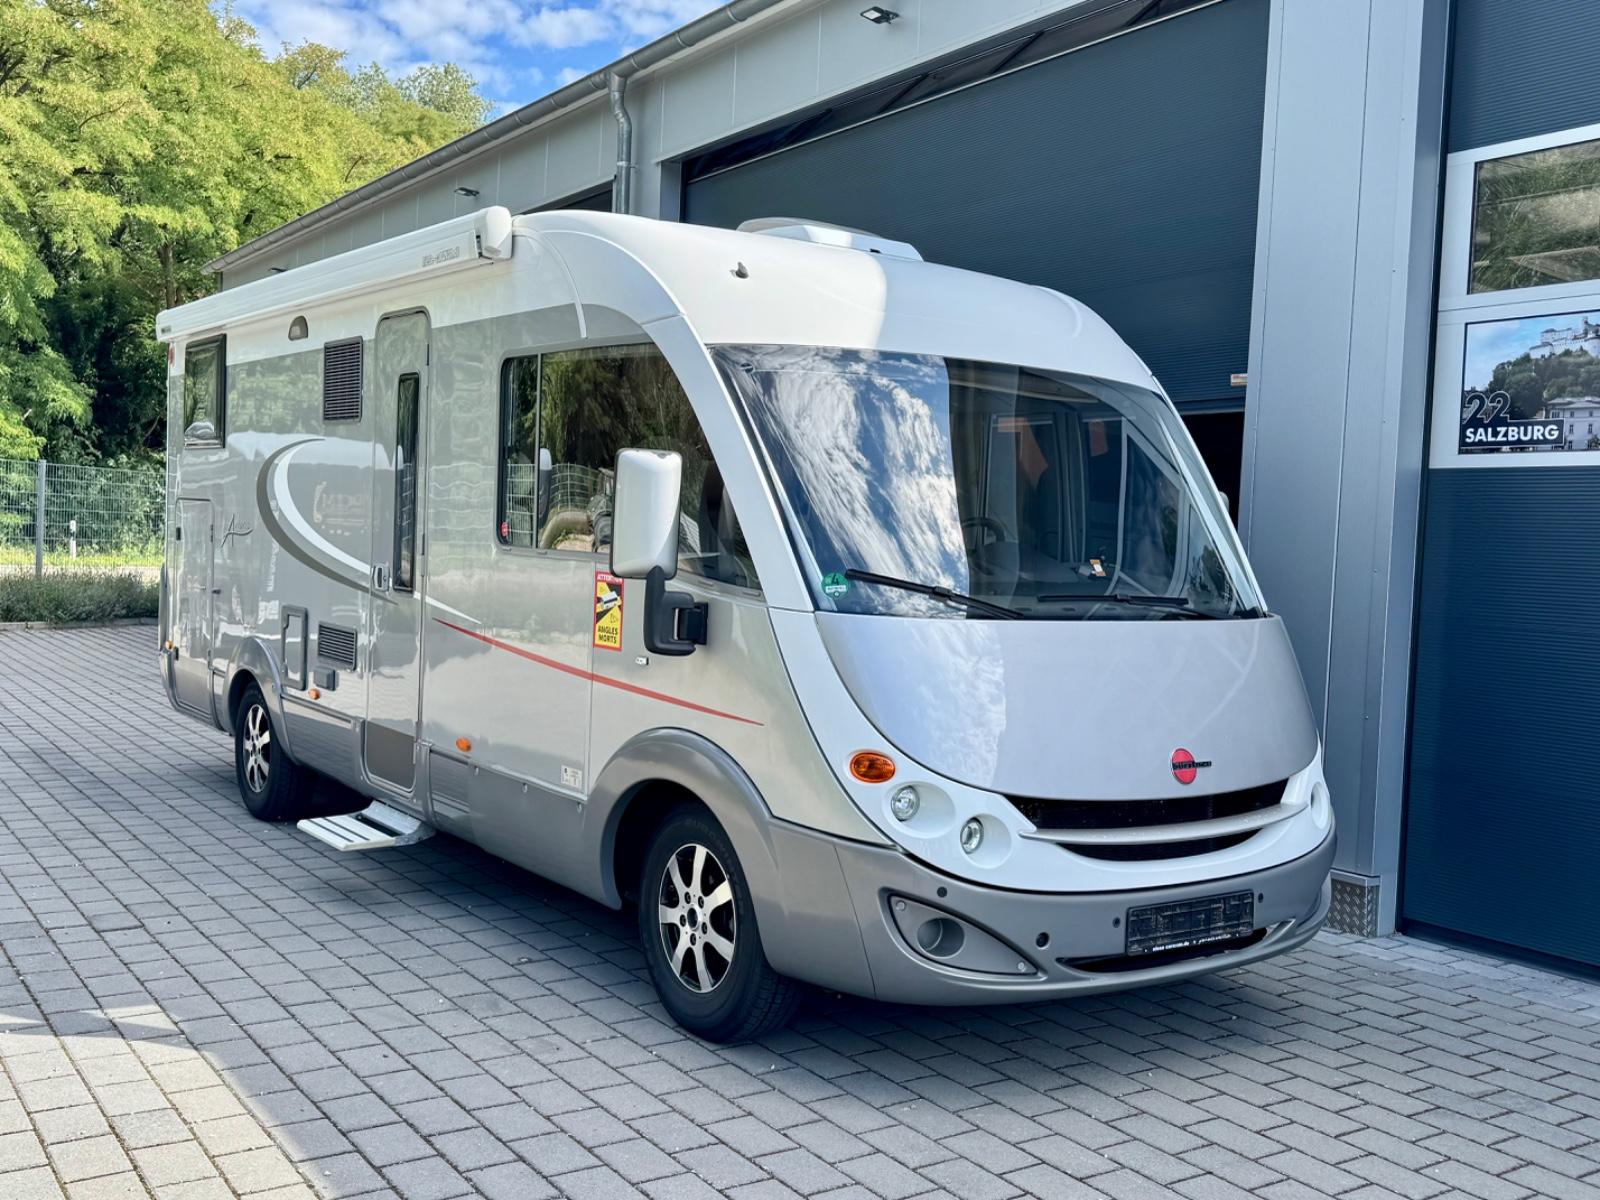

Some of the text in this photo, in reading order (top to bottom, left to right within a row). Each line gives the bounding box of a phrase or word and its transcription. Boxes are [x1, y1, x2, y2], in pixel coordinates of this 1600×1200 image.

[1461, 391, 1511, 424] 22
[1465, 424, 1560, 443] SALZBURG
[597, 625, 618, 636] ANGLES
[598, 633, 617, 644] MORTS
